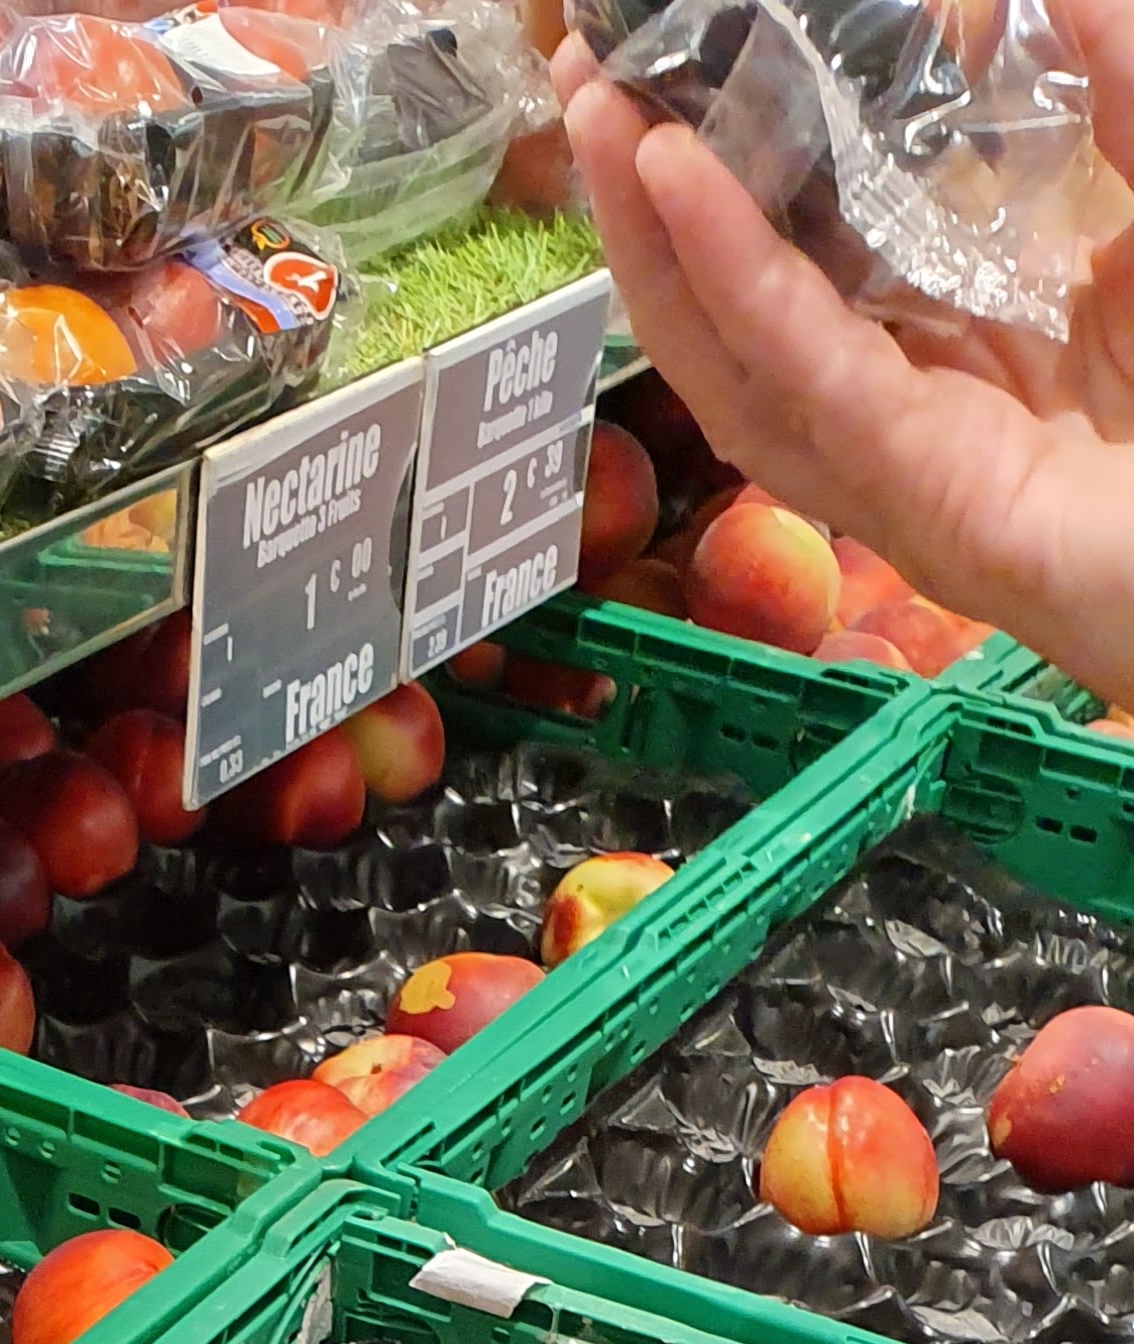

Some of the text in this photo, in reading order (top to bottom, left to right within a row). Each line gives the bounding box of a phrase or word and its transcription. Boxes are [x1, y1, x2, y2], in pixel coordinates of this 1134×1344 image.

[484, 331, 558, 412] Pêche
[243, 423, 381, 550] Nectarine
[318, 504, 326, 533] 3
[501, 469, 516, 525] 2
[305, 573, 316, 630] 1
[352, 537, 372, 578] 00
[481, 545, 558, 628] France
[286, 642, 374, 746] France
